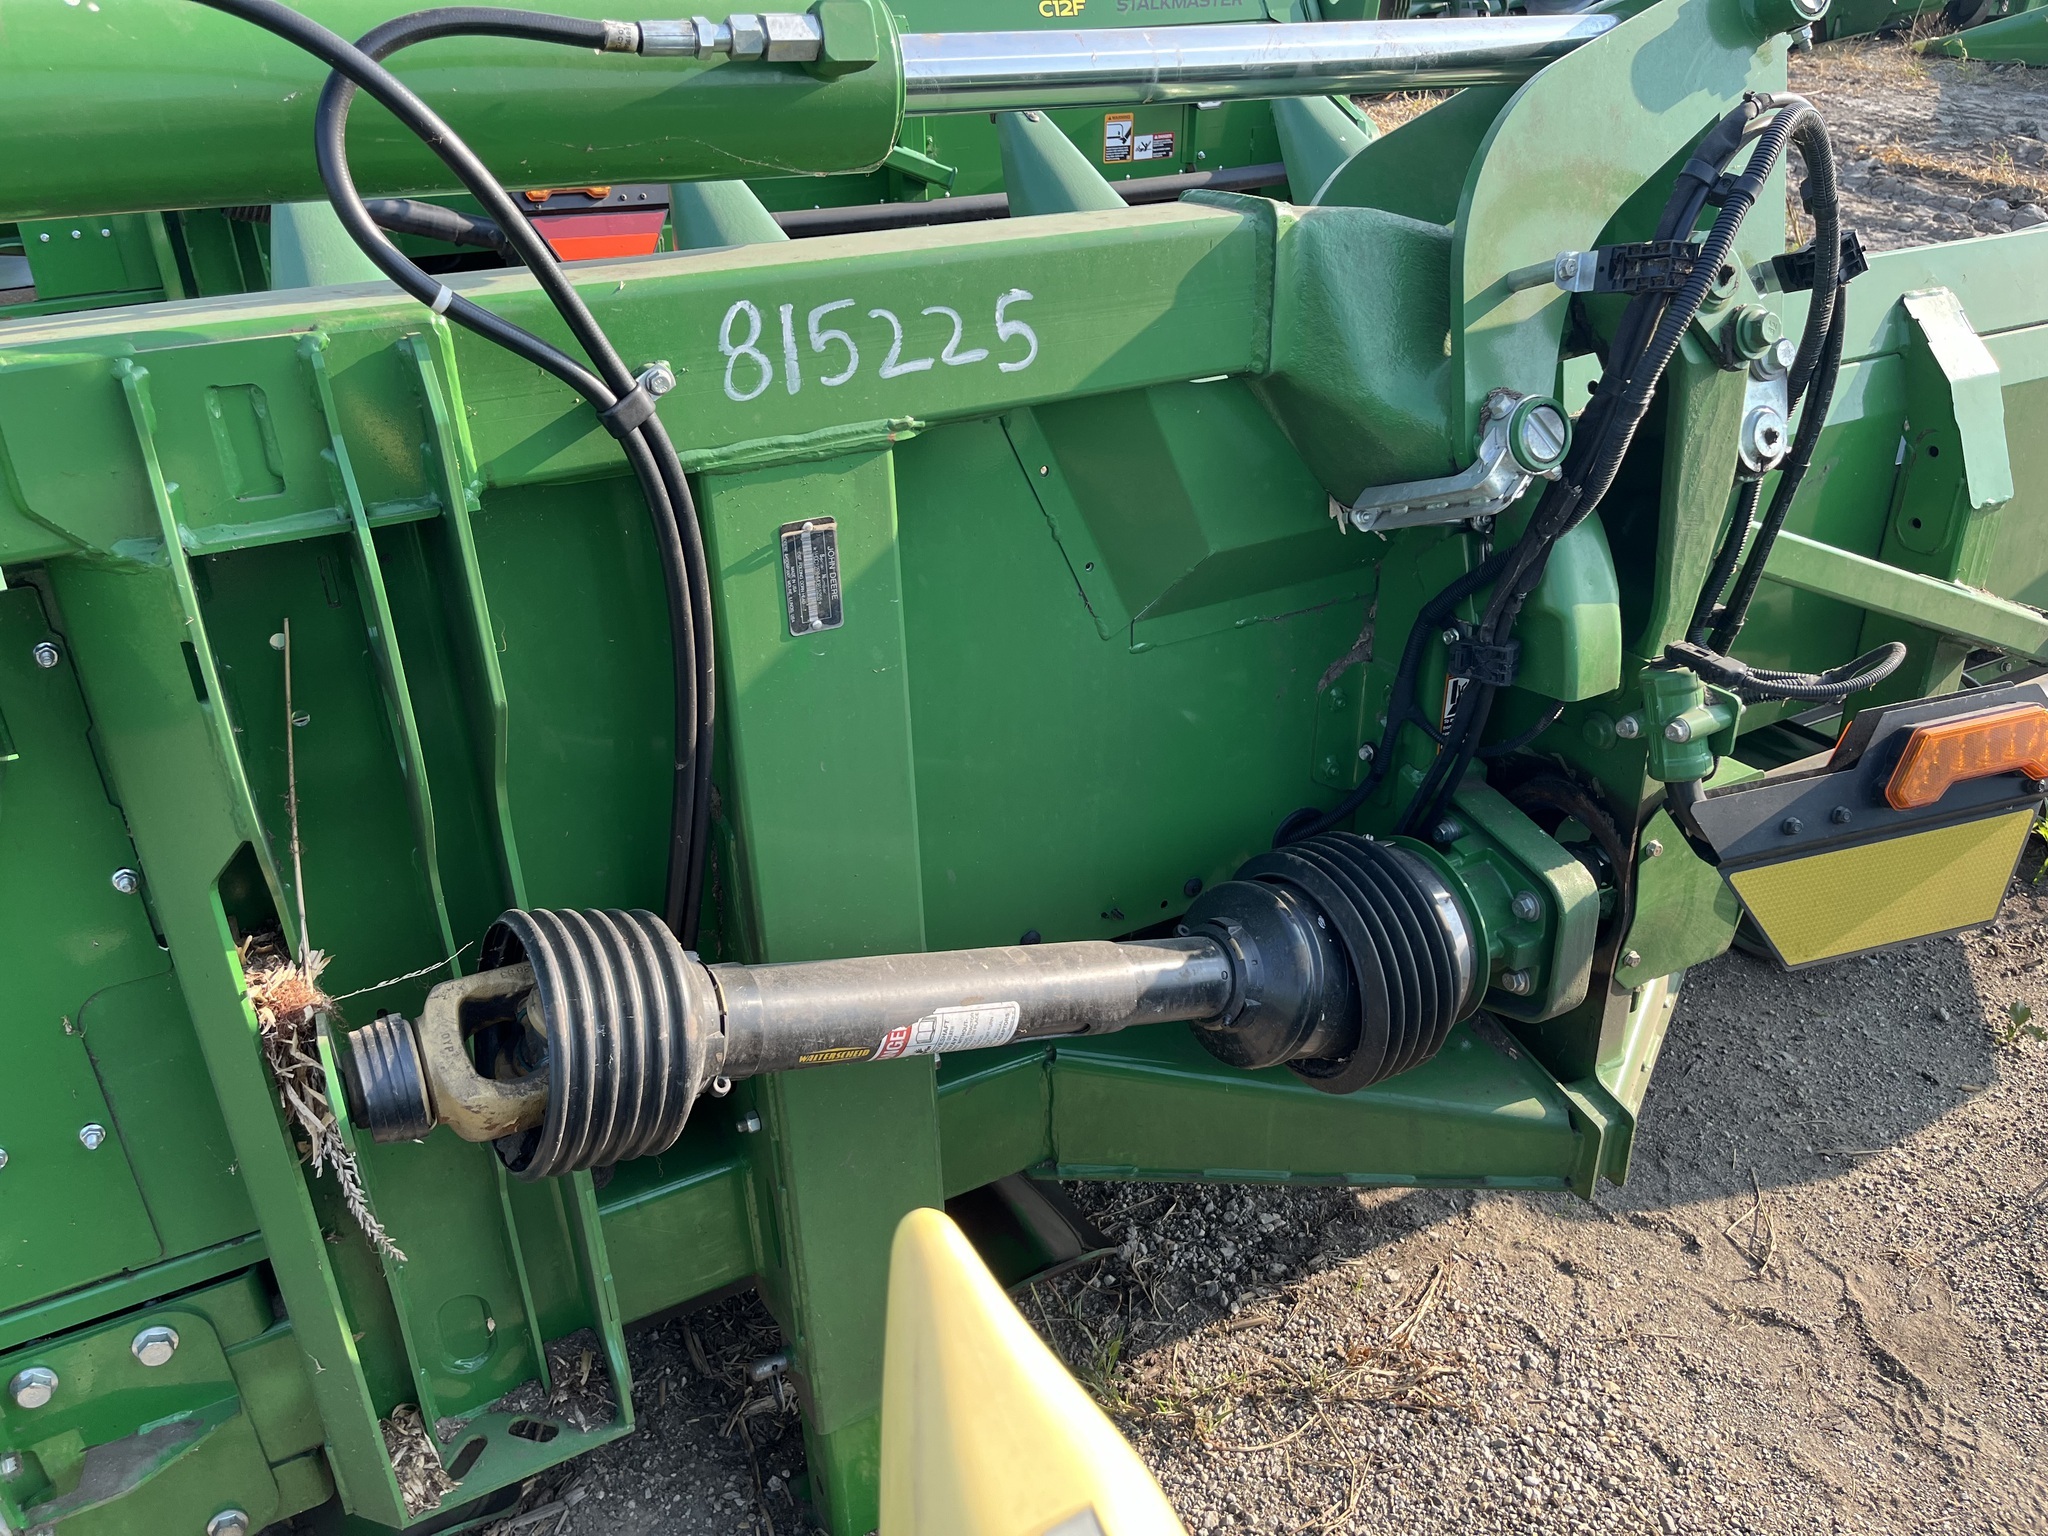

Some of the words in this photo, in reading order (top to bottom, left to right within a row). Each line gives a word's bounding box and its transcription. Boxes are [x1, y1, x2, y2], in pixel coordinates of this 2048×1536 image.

[1038, 0, 1086, 18] C12F
[1116, 0, 1243, 12] STALKMASTER
[718, 287, 1038, 402] 815225
[827, 545, 835, 570] JOHN
[829, 573, 839, 600] DEERE
[798, 1048, 871, 1063] WALTERSCHEID
